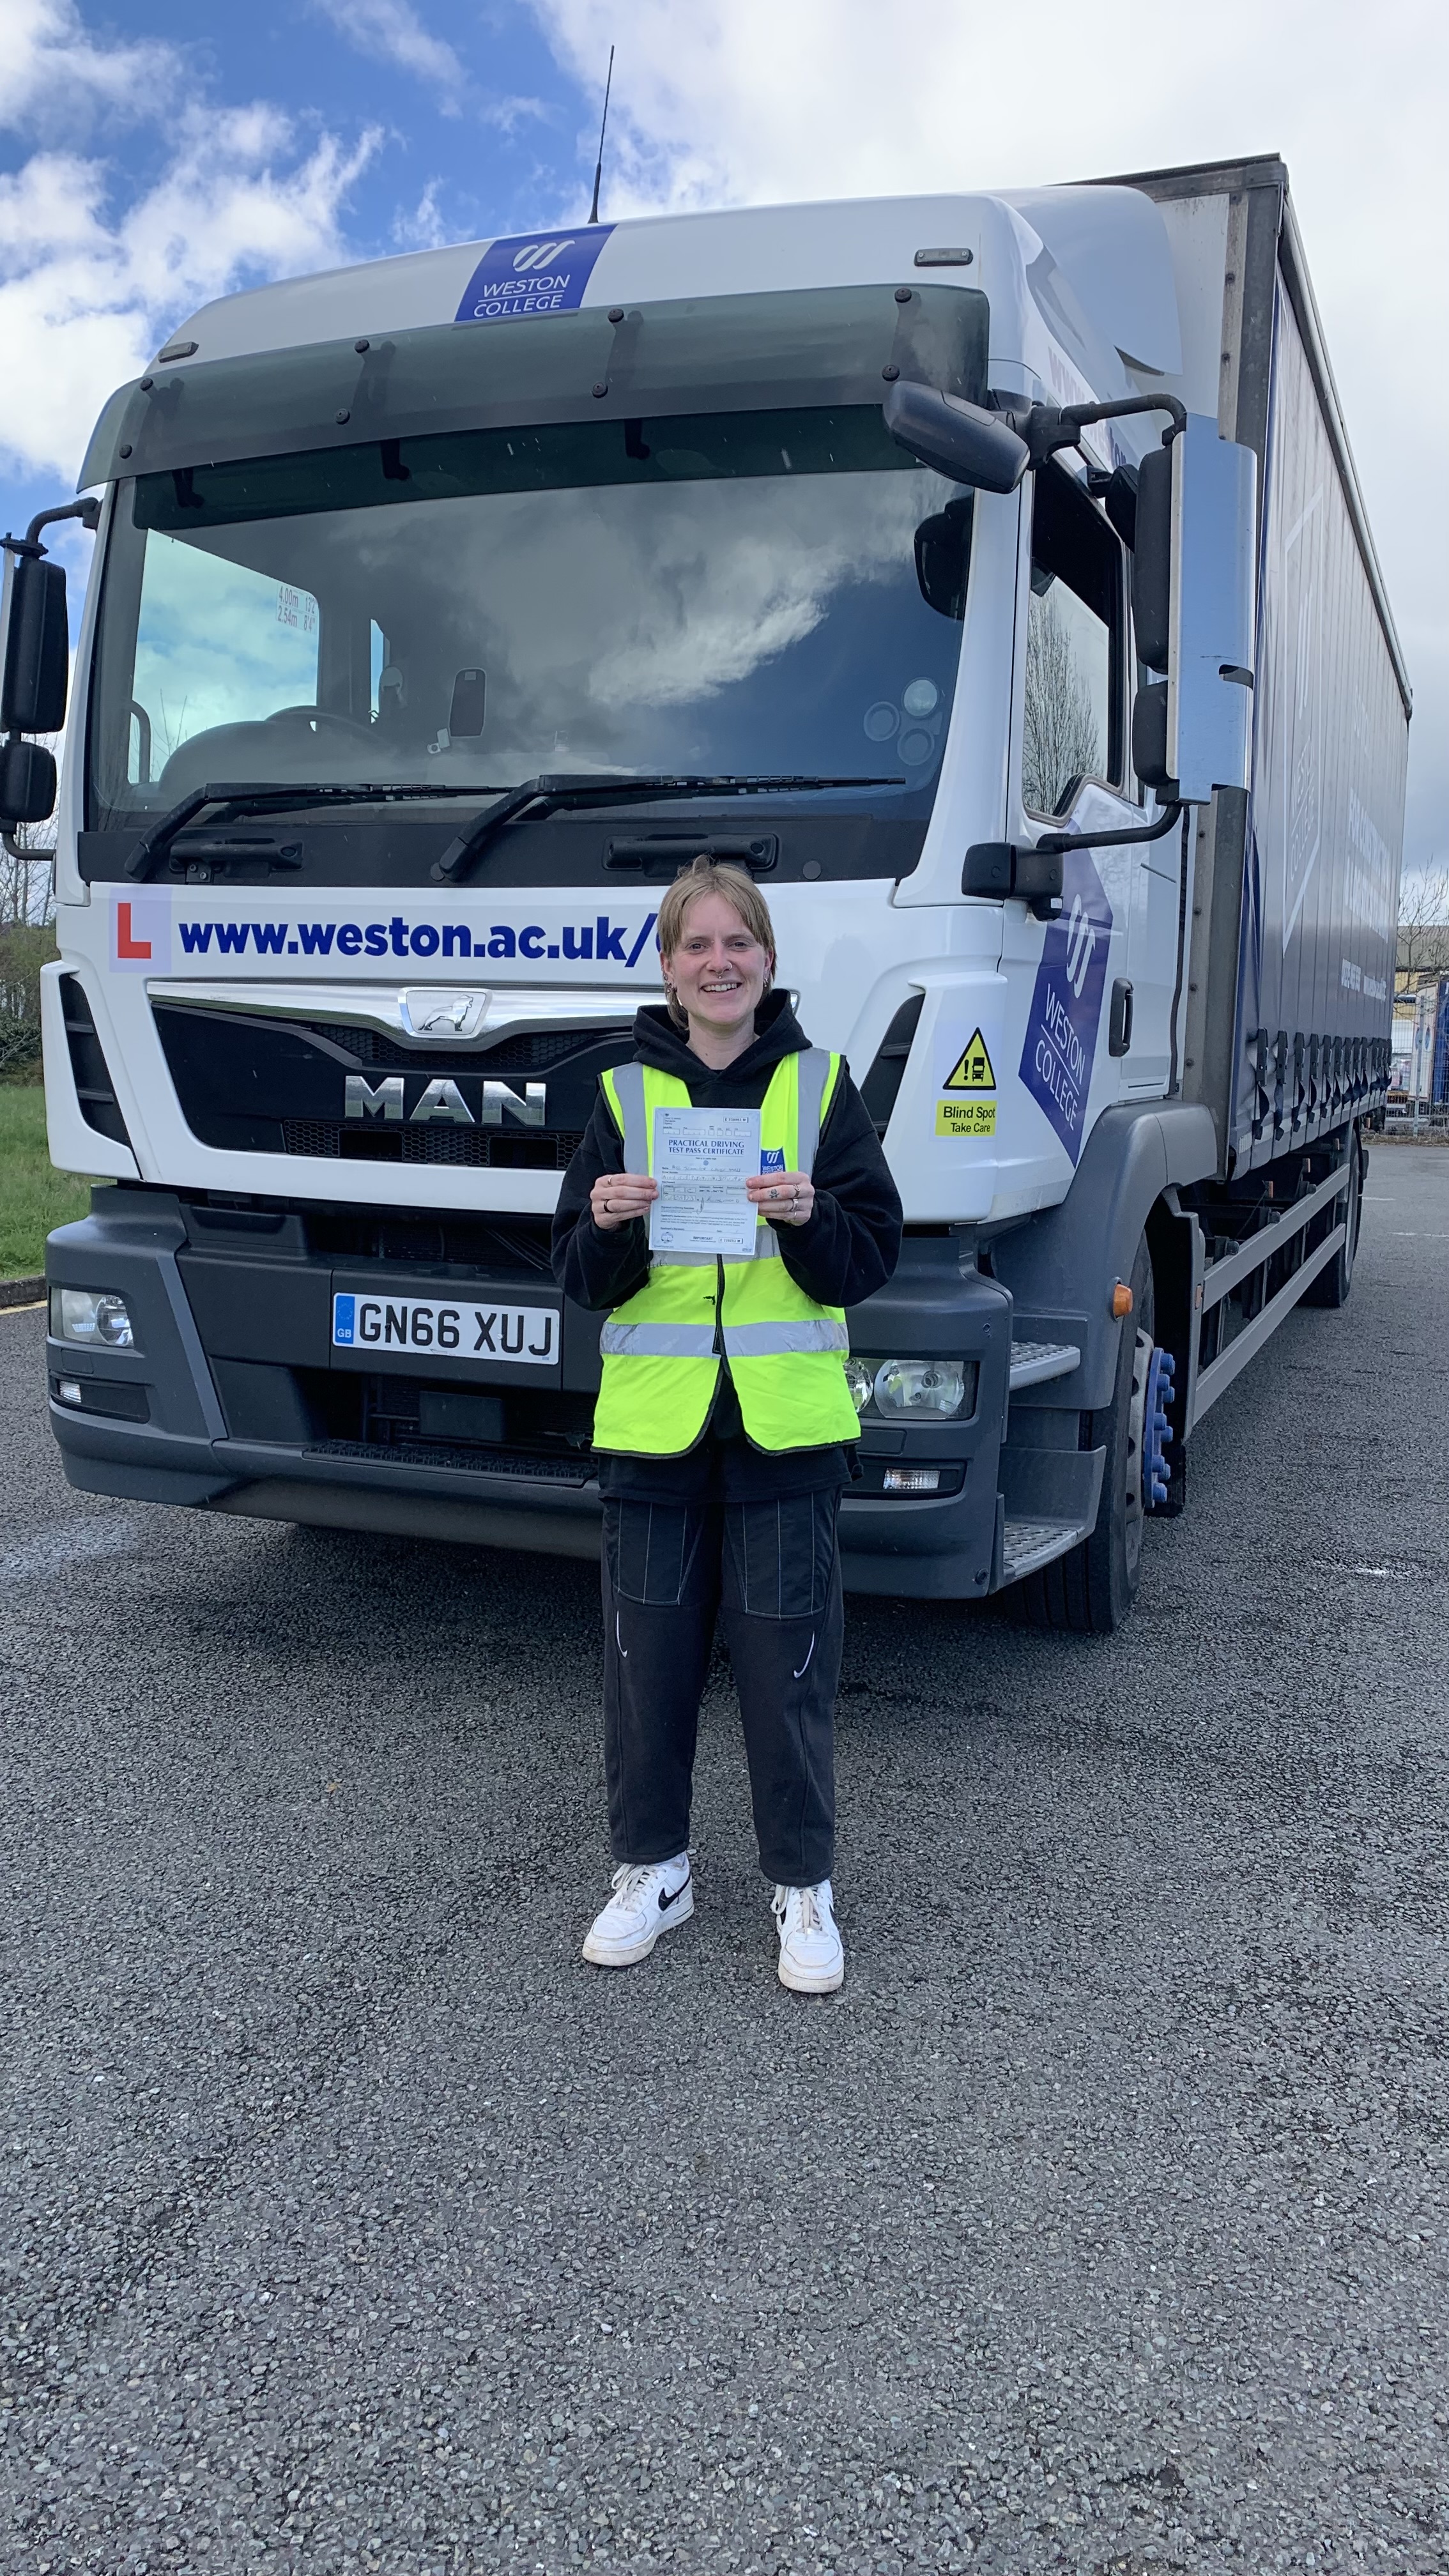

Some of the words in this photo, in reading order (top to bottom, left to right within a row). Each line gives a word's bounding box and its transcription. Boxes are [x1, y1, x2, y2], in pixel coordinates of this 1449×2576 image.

[484, 275, 571, 297] WESTON
[473, 295, 564, 318] COLLEGE
[279, 585, 298, 608] 4.00m
[277, 605, 298, 627] 2.54m
[117, 902, 151, 958] L
[179, 912, 661, 968] www.weston.ac.uk/
[1045, 983, 1085, 1085] WESTON
[1036, 1039, 1078, 1131] COLLEGE
[345, 1075, 546, 1126] MAN
[944, 1106, 974, 1118] Blind
[976, 1106, 995, 1121] Spot
[951, 1123, 972, 1133] Take
[974, 1123, 991, 1133] Care
[337, 1328, 352, 1338] GB
[359, 1303, 461, 1349] GN66
[473, 1311, 552, 1356] XUJ
